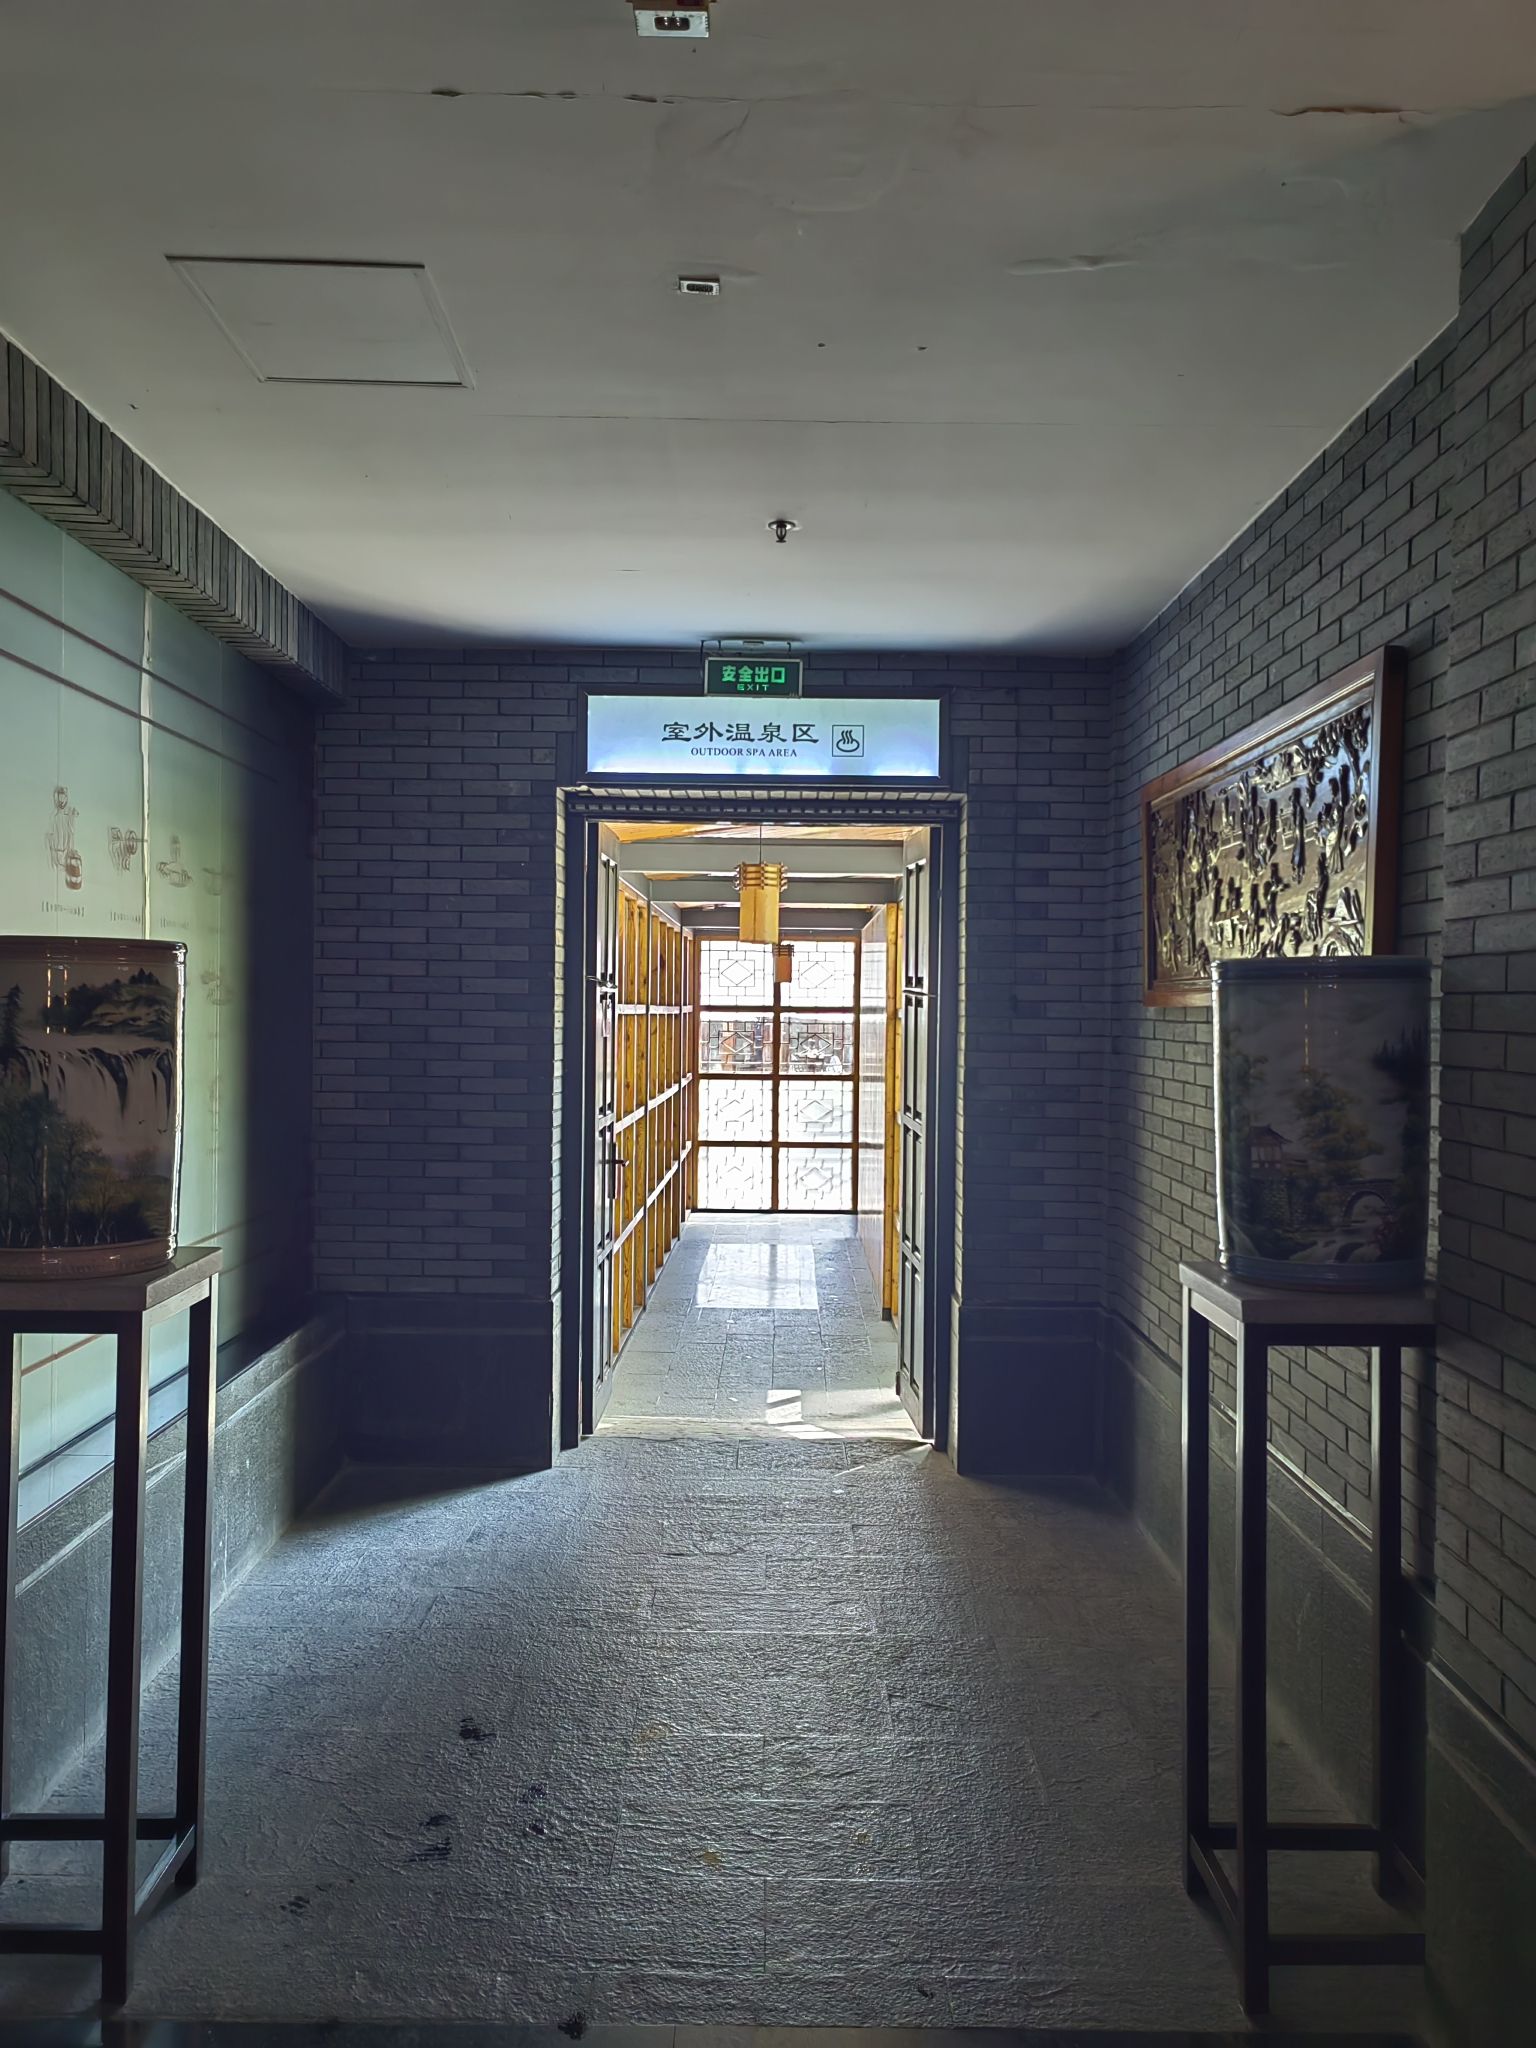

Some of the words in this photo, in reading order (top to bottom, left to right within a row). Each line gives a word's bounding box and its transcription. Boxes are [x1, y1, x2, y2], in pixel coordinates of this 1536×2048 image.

[721, 665, 786, 684] 安全出口
[736, 683, 769, 692] EXIT
[661, 721, 820, 744] 室外温泉区
[690, 747, 744, 757] OUTDOOR
[745, 747, 766, 757] SPA
[768, 748, 797, 758] AREA
